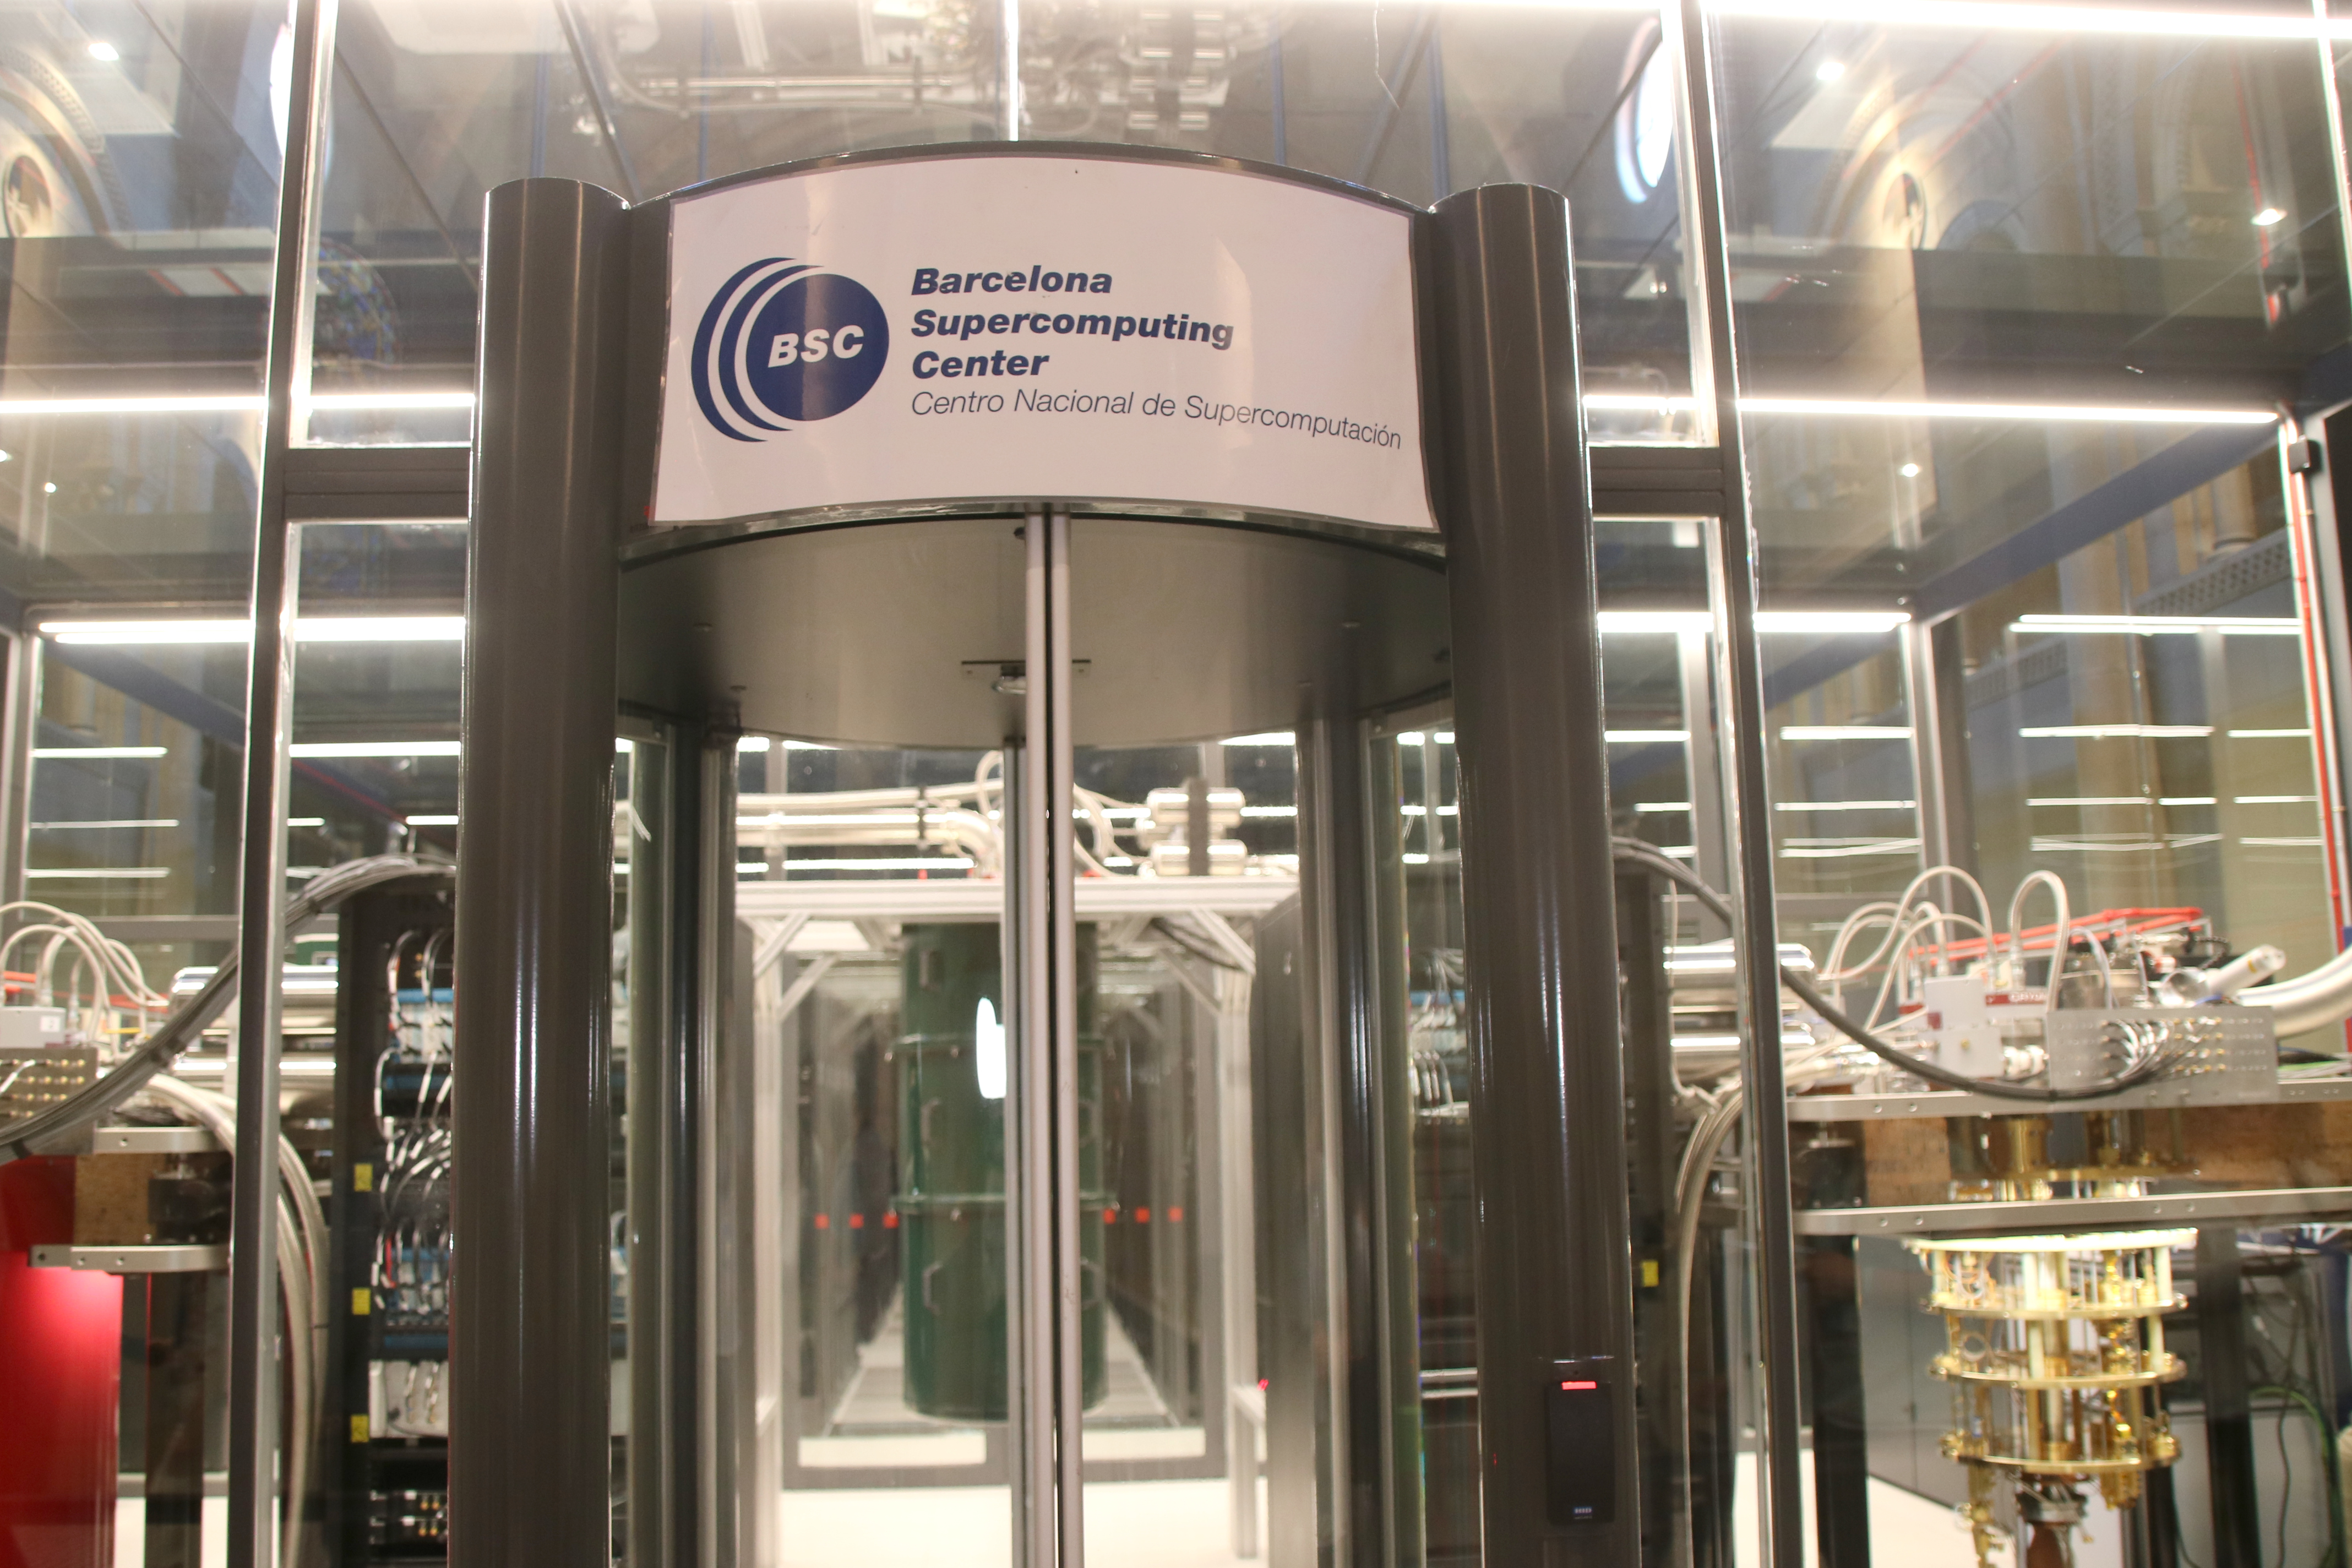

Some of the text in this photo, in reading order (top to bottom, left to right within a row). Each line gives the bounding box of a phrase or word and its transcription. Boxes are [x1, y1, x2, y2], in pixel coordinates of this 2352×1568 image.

[911, 264, 1113, 296] Barcelona
[767, 325, 864, 368] BSC
[911, 309, 1234, 351] Supercomputing
[912, 350, 1050, 380] Center
[912, 389, 1401, 449] Centro Nacional de Supercomputación
